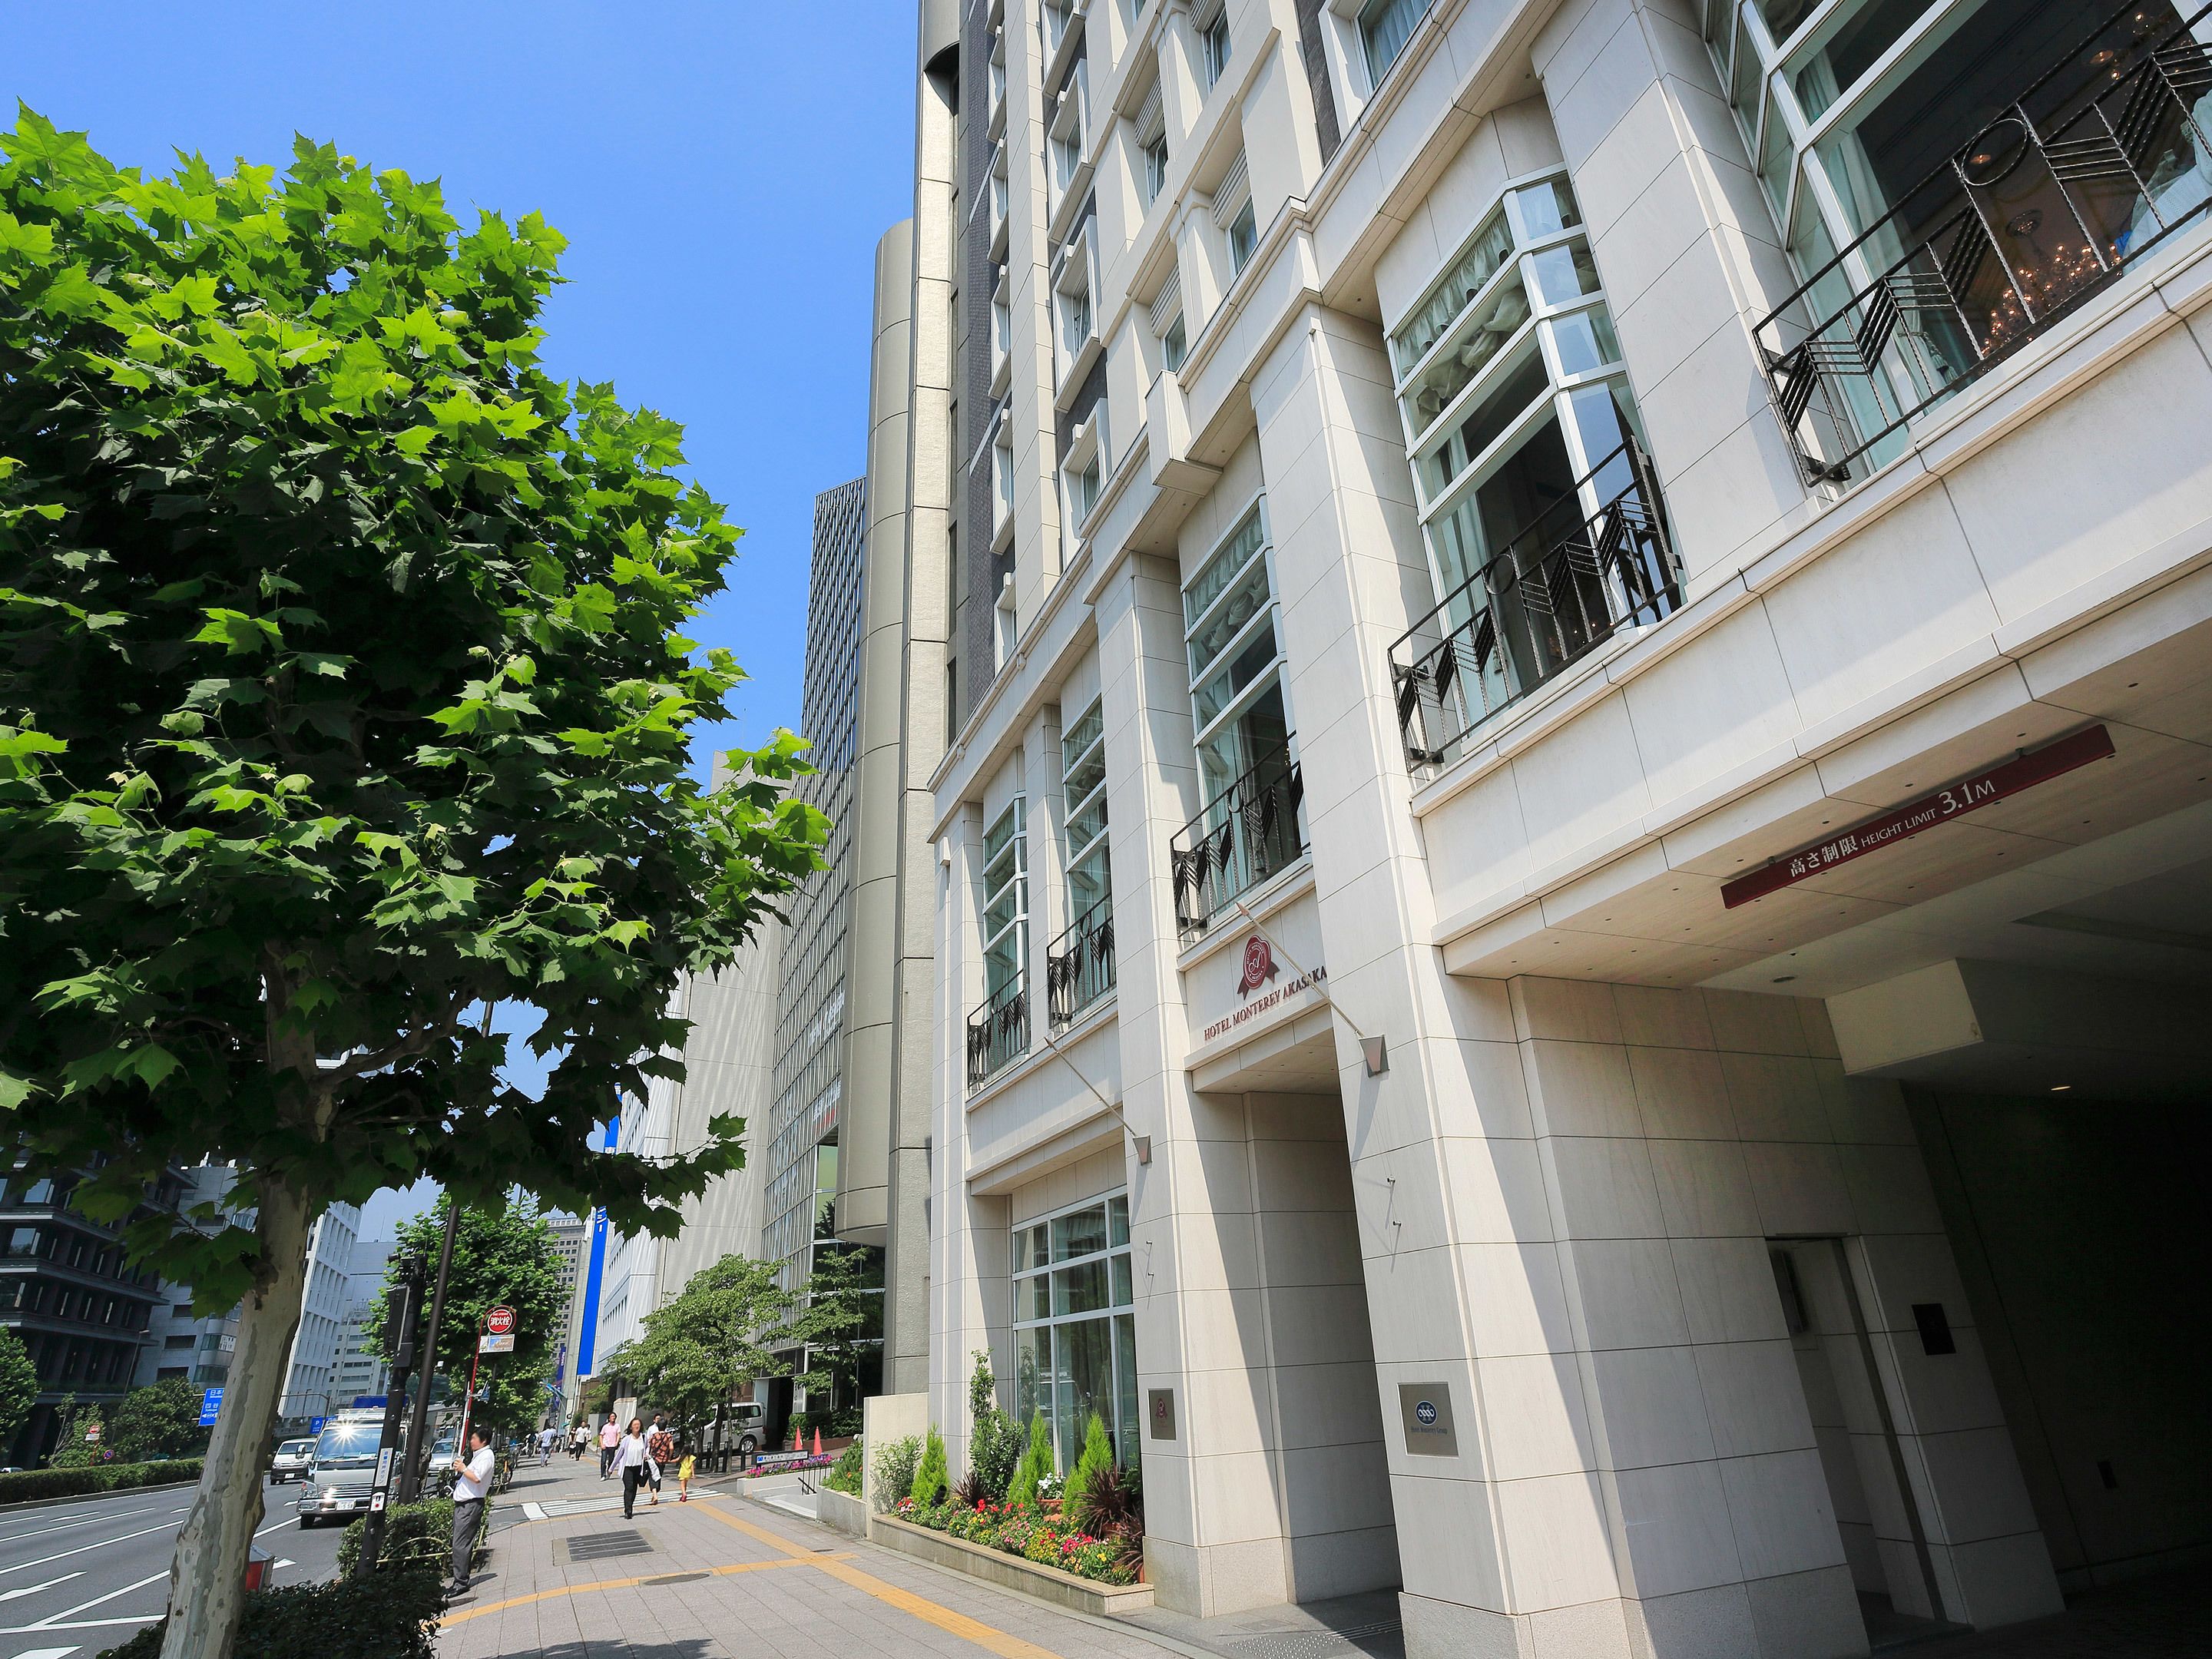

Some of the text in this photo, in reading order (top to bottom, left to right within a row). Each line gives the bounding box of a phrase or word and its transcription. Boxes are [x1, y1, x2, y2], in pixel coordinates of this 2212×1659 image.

[1861, 823, 1902, 847] HEIGHT
[1905, 808, 1936, 830] LIMIT
[1789, 835, 1858, 877] 高さ制限
[1204, 1018, 1231, 1041] HOTEL
[1233, 989, 1281, 1026] MONTEREY
[489, 1316, 511, 1326] 消火栓
